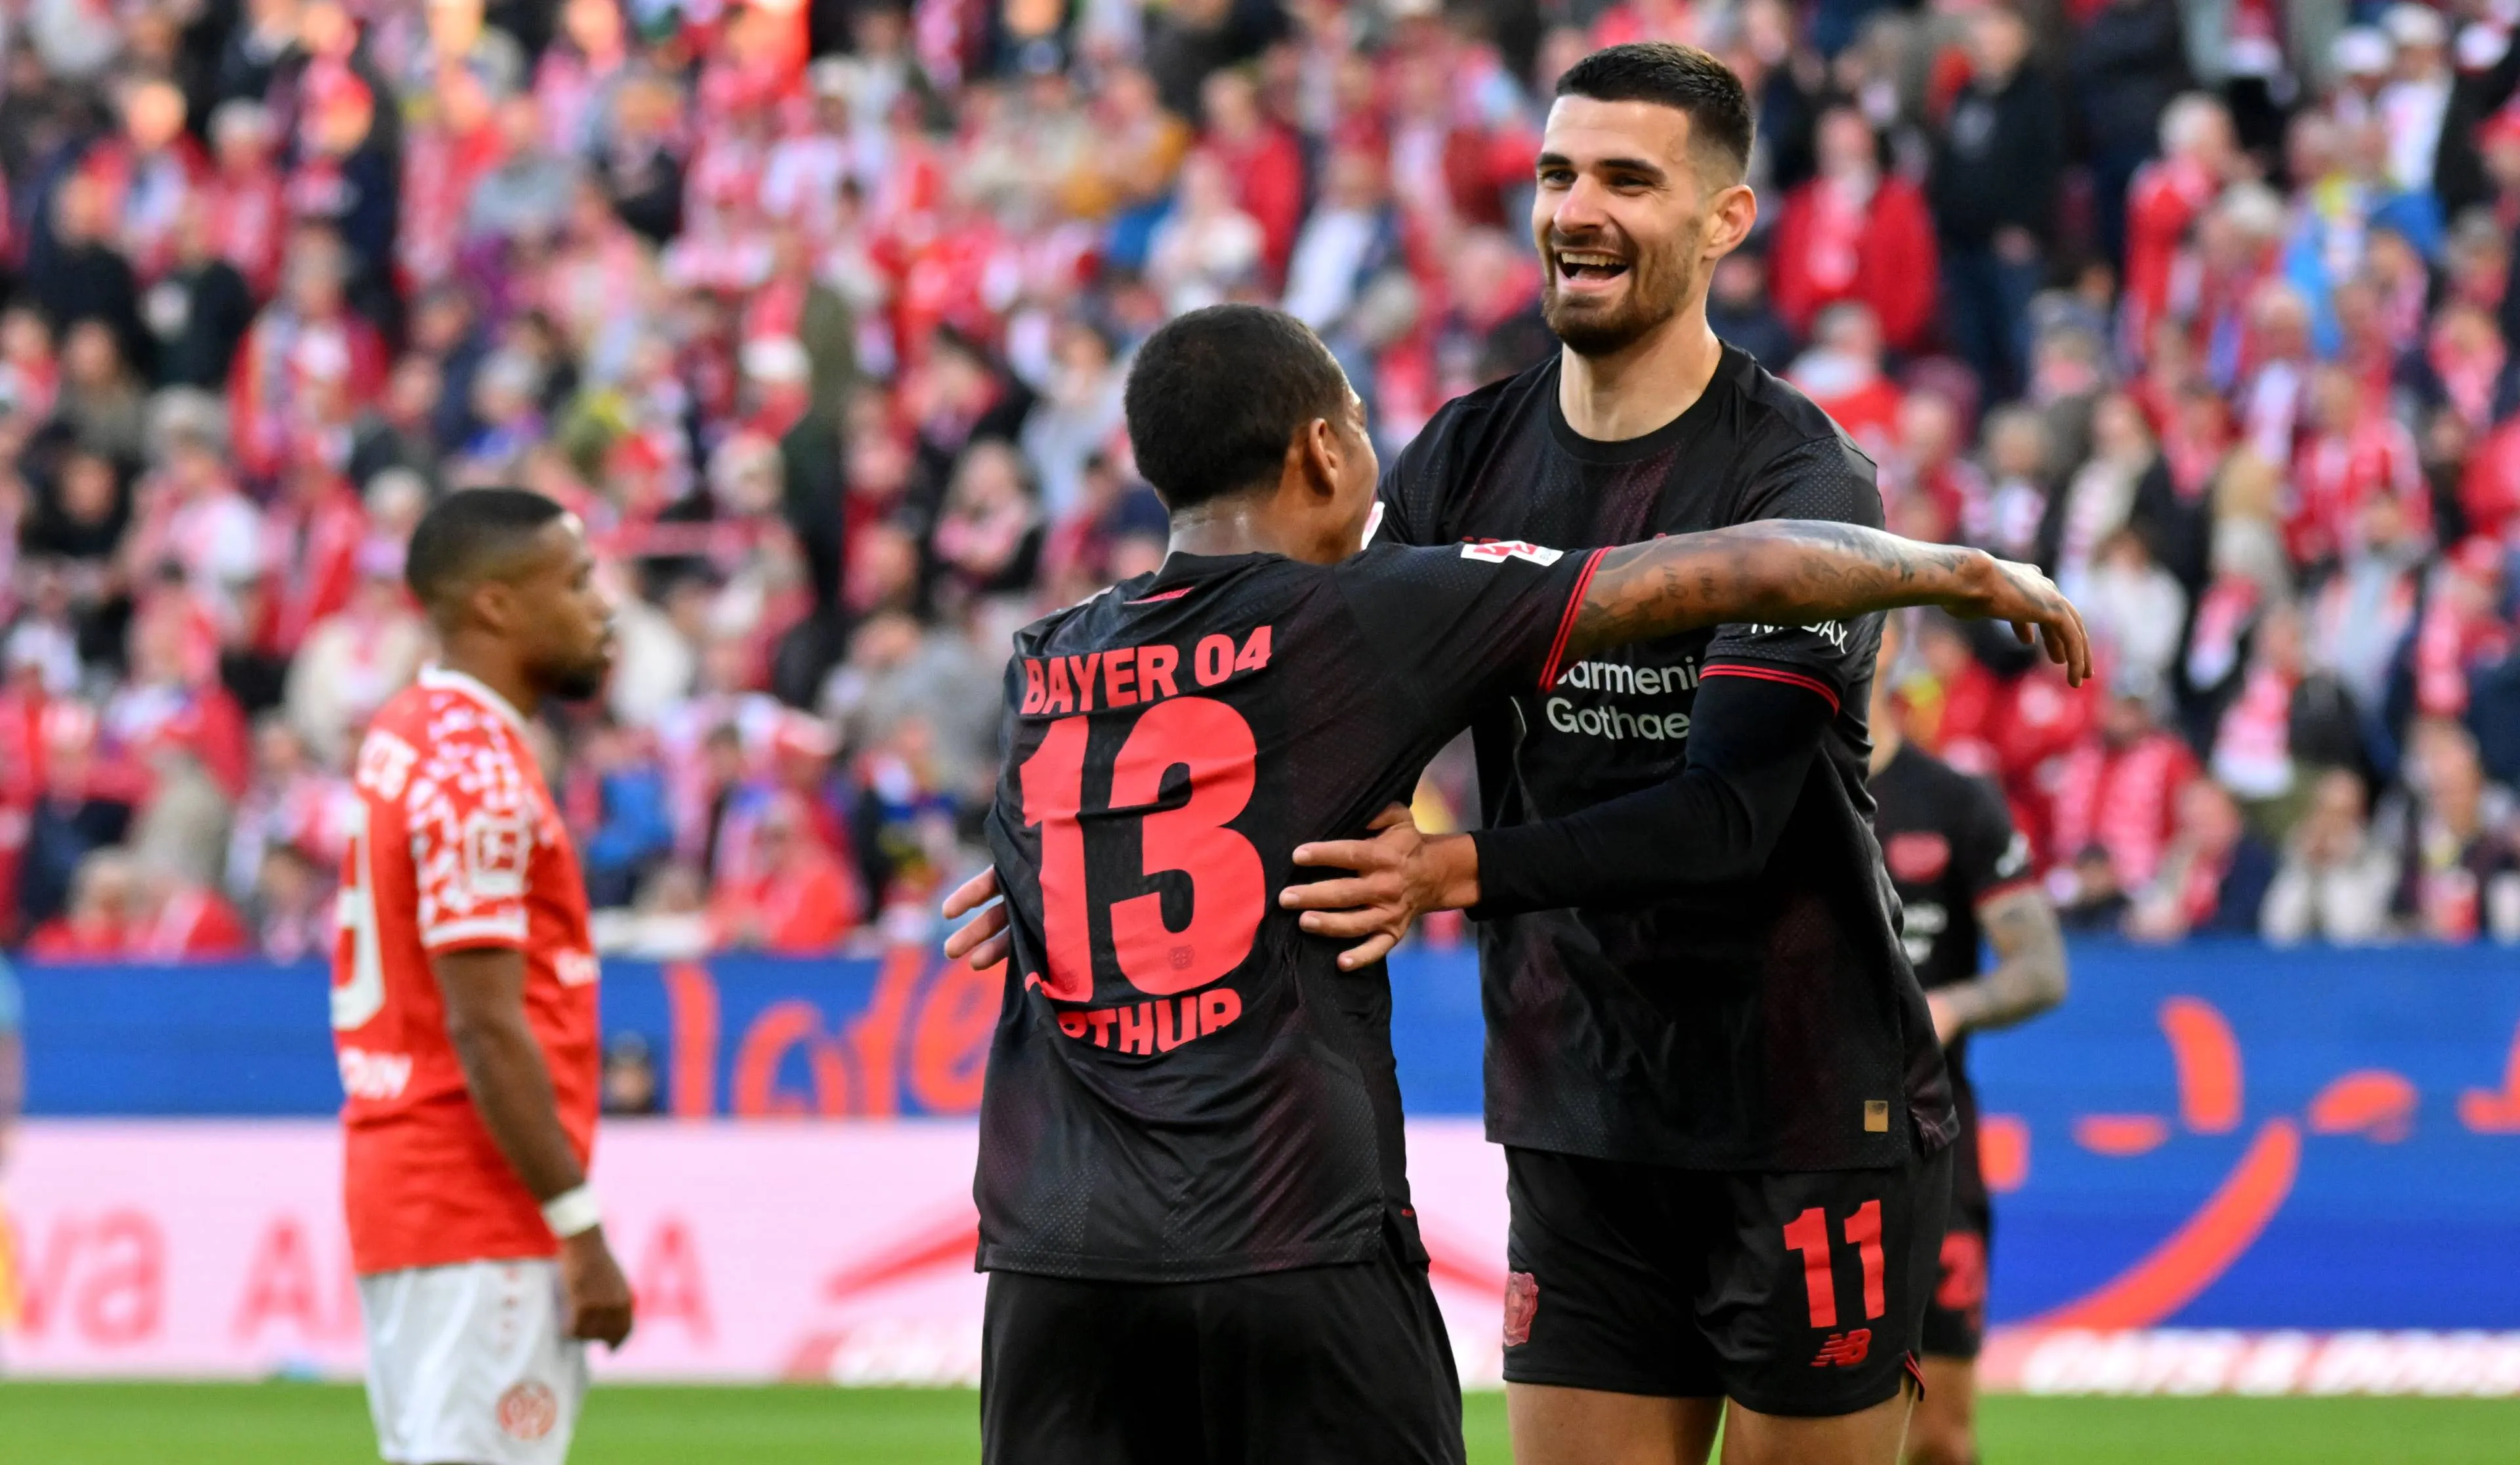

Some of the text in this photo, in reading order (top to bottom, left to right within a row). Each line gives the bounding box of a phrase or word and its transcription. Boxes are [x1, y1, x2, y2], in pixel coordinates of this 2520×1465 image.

[1020, 625, 1272, 714] BAYER 04
[1557, 656, 1699, 695] armeni
[1546, 697, 1691, 740] Gothae
[1019, 696, 1266, 1002] 13
[1783, 1199, 1885, 1329] 11
